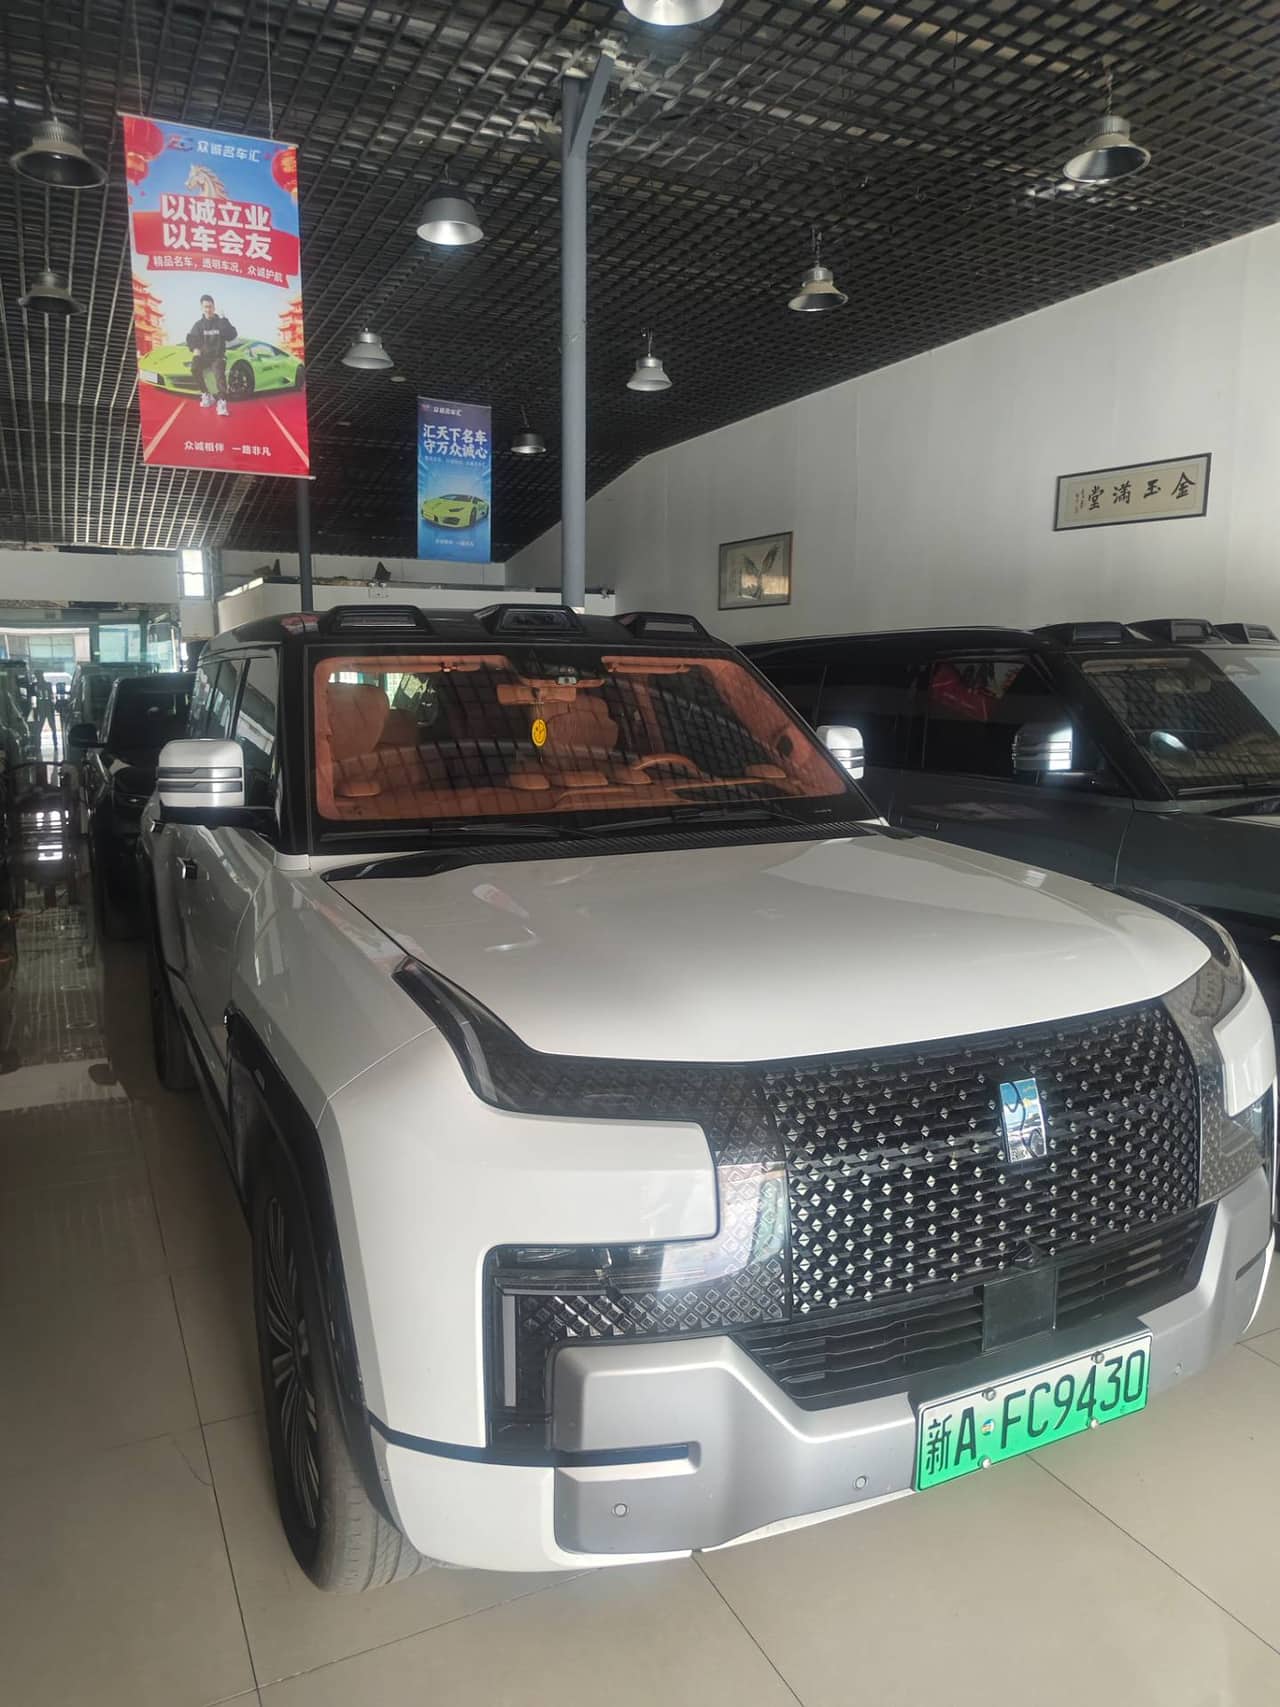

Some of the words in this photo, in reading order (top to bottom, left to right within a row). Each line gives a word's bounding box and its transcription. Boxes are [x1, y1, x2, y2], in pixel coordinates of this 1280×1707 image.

[161, 194, 271, 231] 以诚立业
[163, 223, 273, 261] 以车会友
[423, 424, 488, 445] 汇天下名车
[423, 439, 488, 459] 守万众诚心
